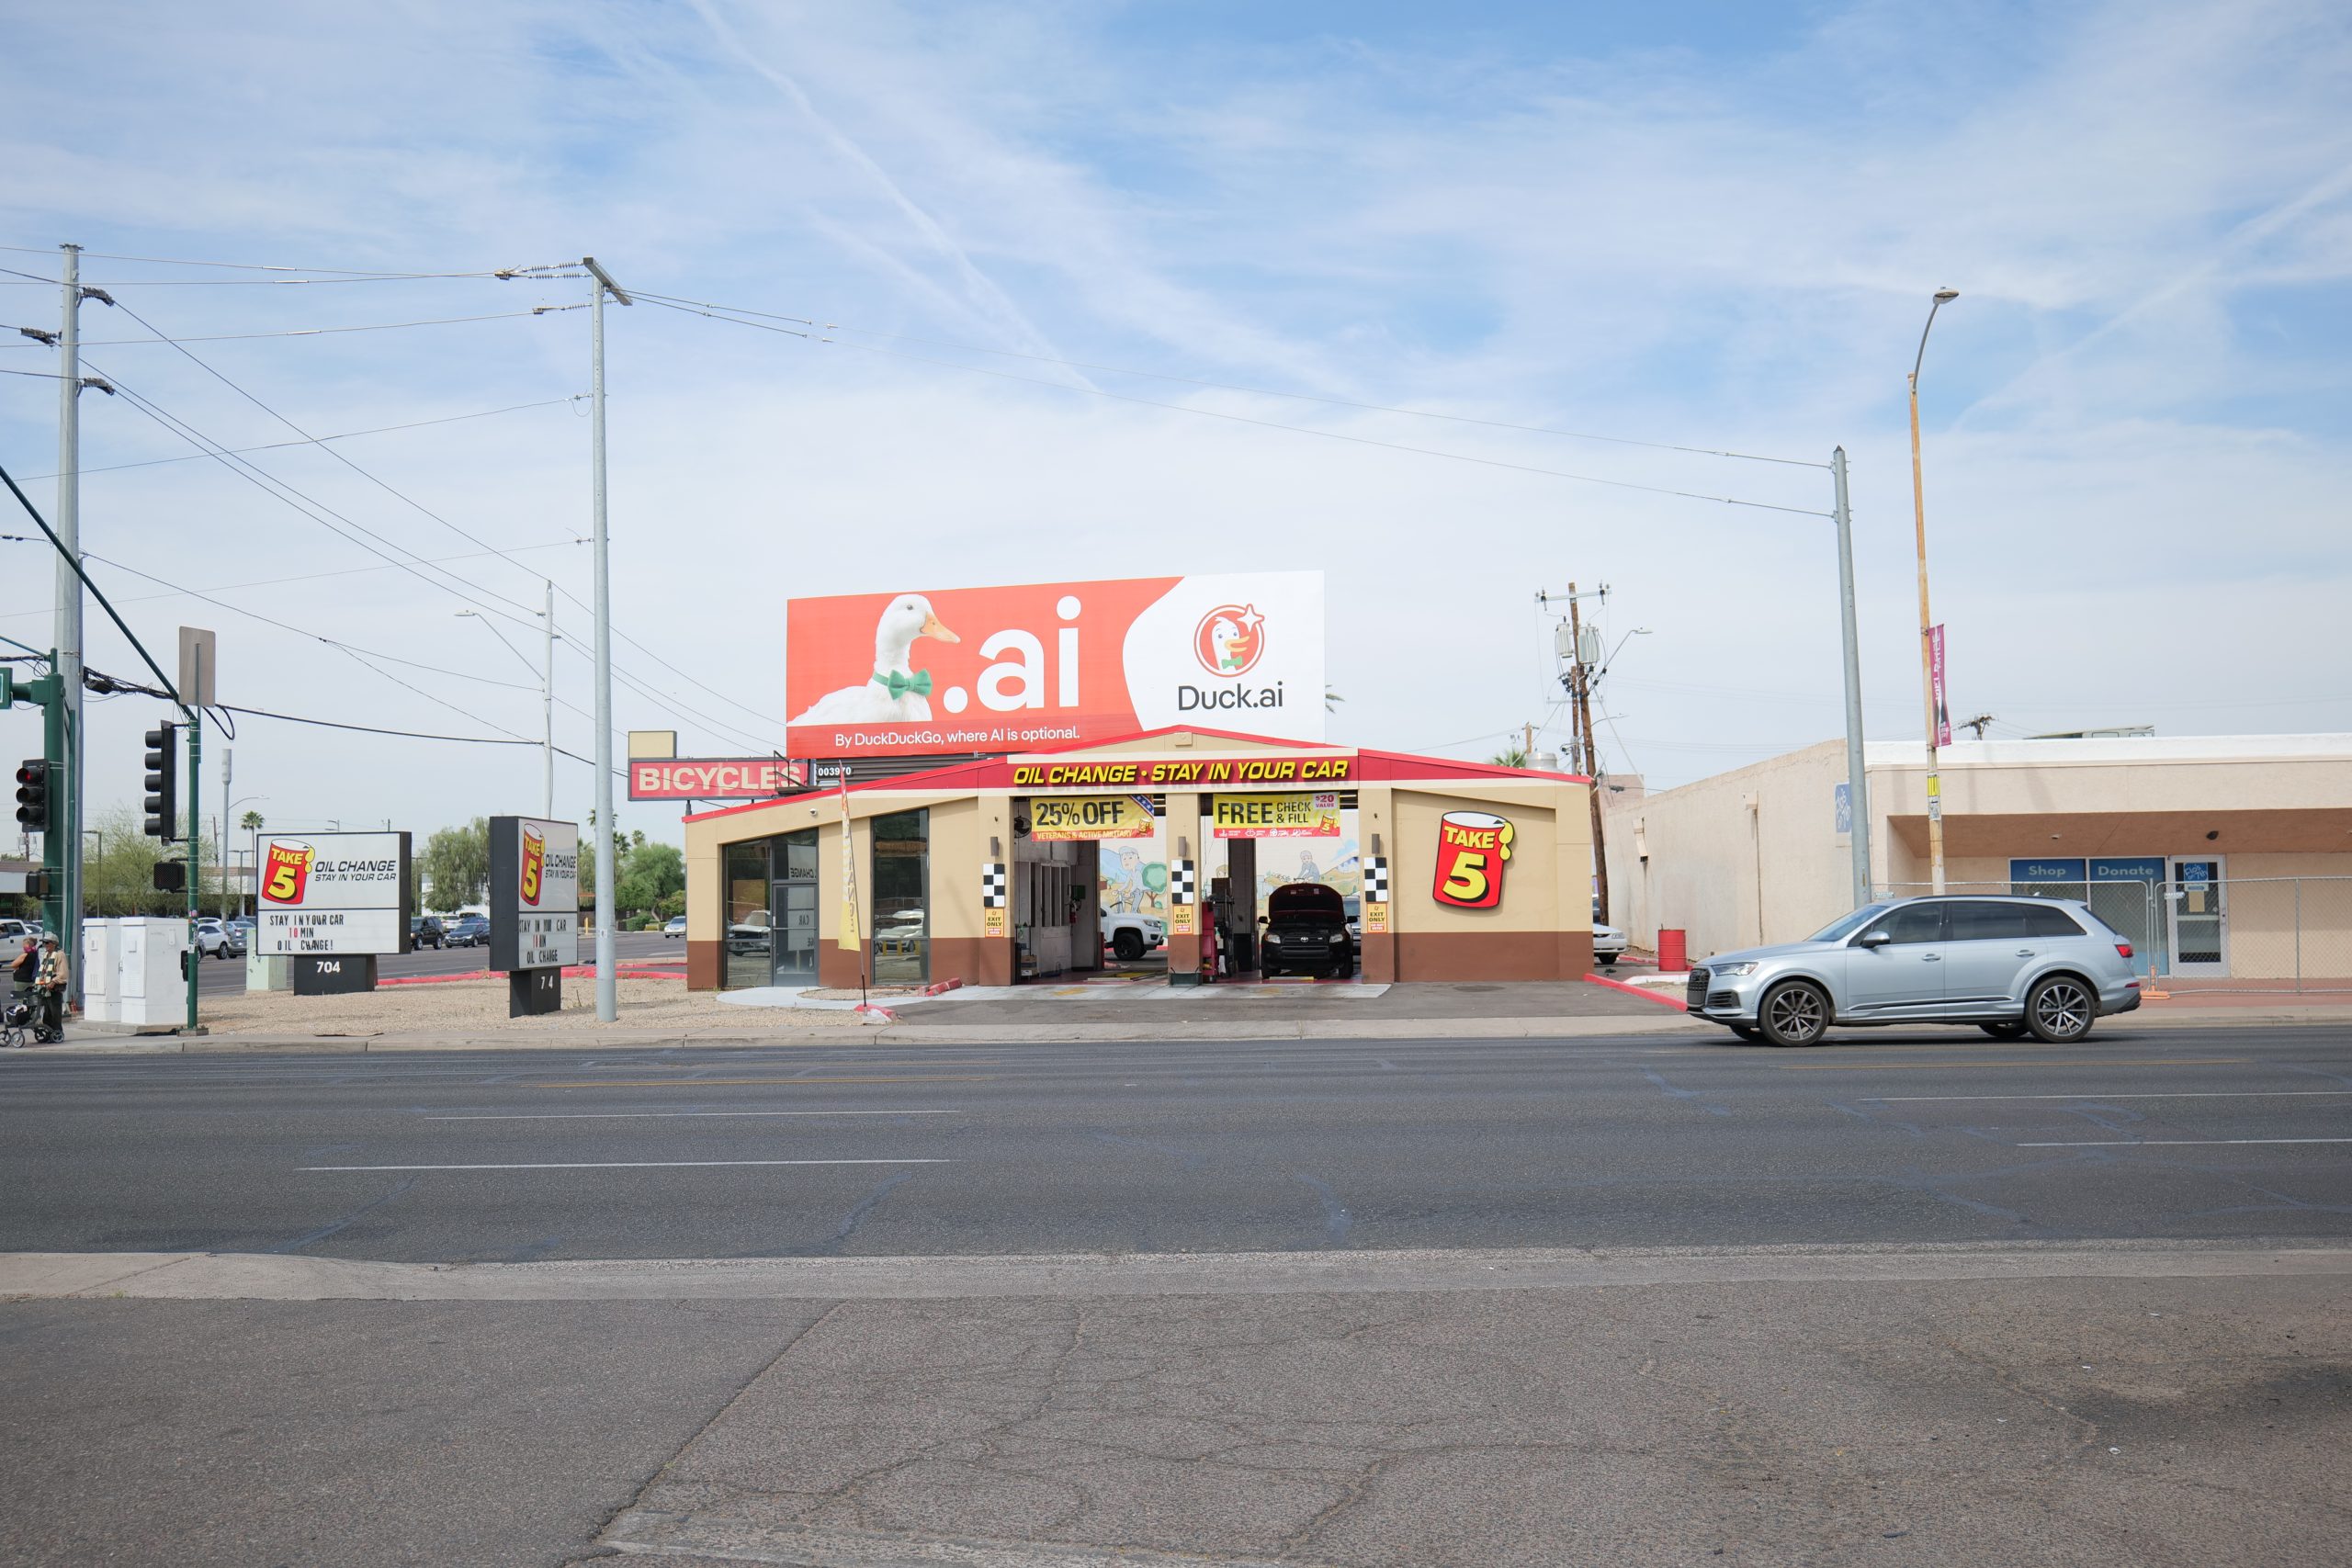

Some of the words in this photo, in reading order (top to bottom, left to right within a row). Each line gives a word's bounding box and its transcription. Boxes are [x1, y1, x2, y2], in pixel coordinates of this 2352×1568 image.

[1178, 681, 1283, 711] Duck.ai
[835, 734, 853, 748] By
[855, 731, 944, 746] DuckDuckGo,
[946, 730, 987, 742] where
[990, 728, 1003, 741] AI
[1007, 728, 1018, 741] is
[1021, 726, 1080, 742] optional.
[639, 765, 800, 791] BICYCLES
[1013, 767, 1045, 784] OIL
[1049, 764, 1137, 784] CHANGE
[1151, 762, 1204, 782] STAY
[1208, 762, 1231, 780] IN
[1238, 761, 1296, 779] YOUR
[1301, 760, 1348, 778] CAR
[1316, 794, 1335, 803] $20
[1036, 802, 1080, 826] 25%
[1082, 801, 1124, 826] OFF
[1217, 802, 1273, 824] FREE
[1276, 801, 1311, 813] CHECK
[1276, 813, 1284, 823] &
[1288, 812, 1309, 823] FILL
[1036, 831, 1071, 840] VETERANS
[1079, 830, 1102, 839] ACTIVE
[1102, 829, 1133, 839] MILITARY
[1444, 826, 1495, 849] TAKE
[525, 835, 540, 857] TAKE
[271, 848, 303, 865] TAKE
[545, 853, 554, 867] OIL
[555, 854, 576, 869] CHANGE
[315, 861, 335, 873] OIL
[338, 860, 397, 873] CHANGE
[2029, 865, 2066, 878] Shop
[2098, 865, 2154, 875] Donate
[314, 874, 335, 882] STAY
[377, 873, 397, 881] CAR
[524, 858, 537, 899] 5
[545, 869, 555, 879] STAY
[560, 870, 570, 879] YOUR
[1442, 851, 1487, 899] 5
[267, 866, 297, 899] 5
[269, 915, 289, 926] STAY
[329, 914, 344, 925] CAR
[519, 919, 530, 933] STAY
[535, 919, 540, 932] IN
[556, 919, 566, 931] CAR
[288, 927, 299, 938] 10
[300, 927, 314, 938] MIN
[277, 940, 292, 951] OIL
[300, 939, 334, 951] CHANGE!
[526, 951, 535, 964] OIL
[538, 949, 558, 963] CHANGE
[316, 961, 341, 974] 704
